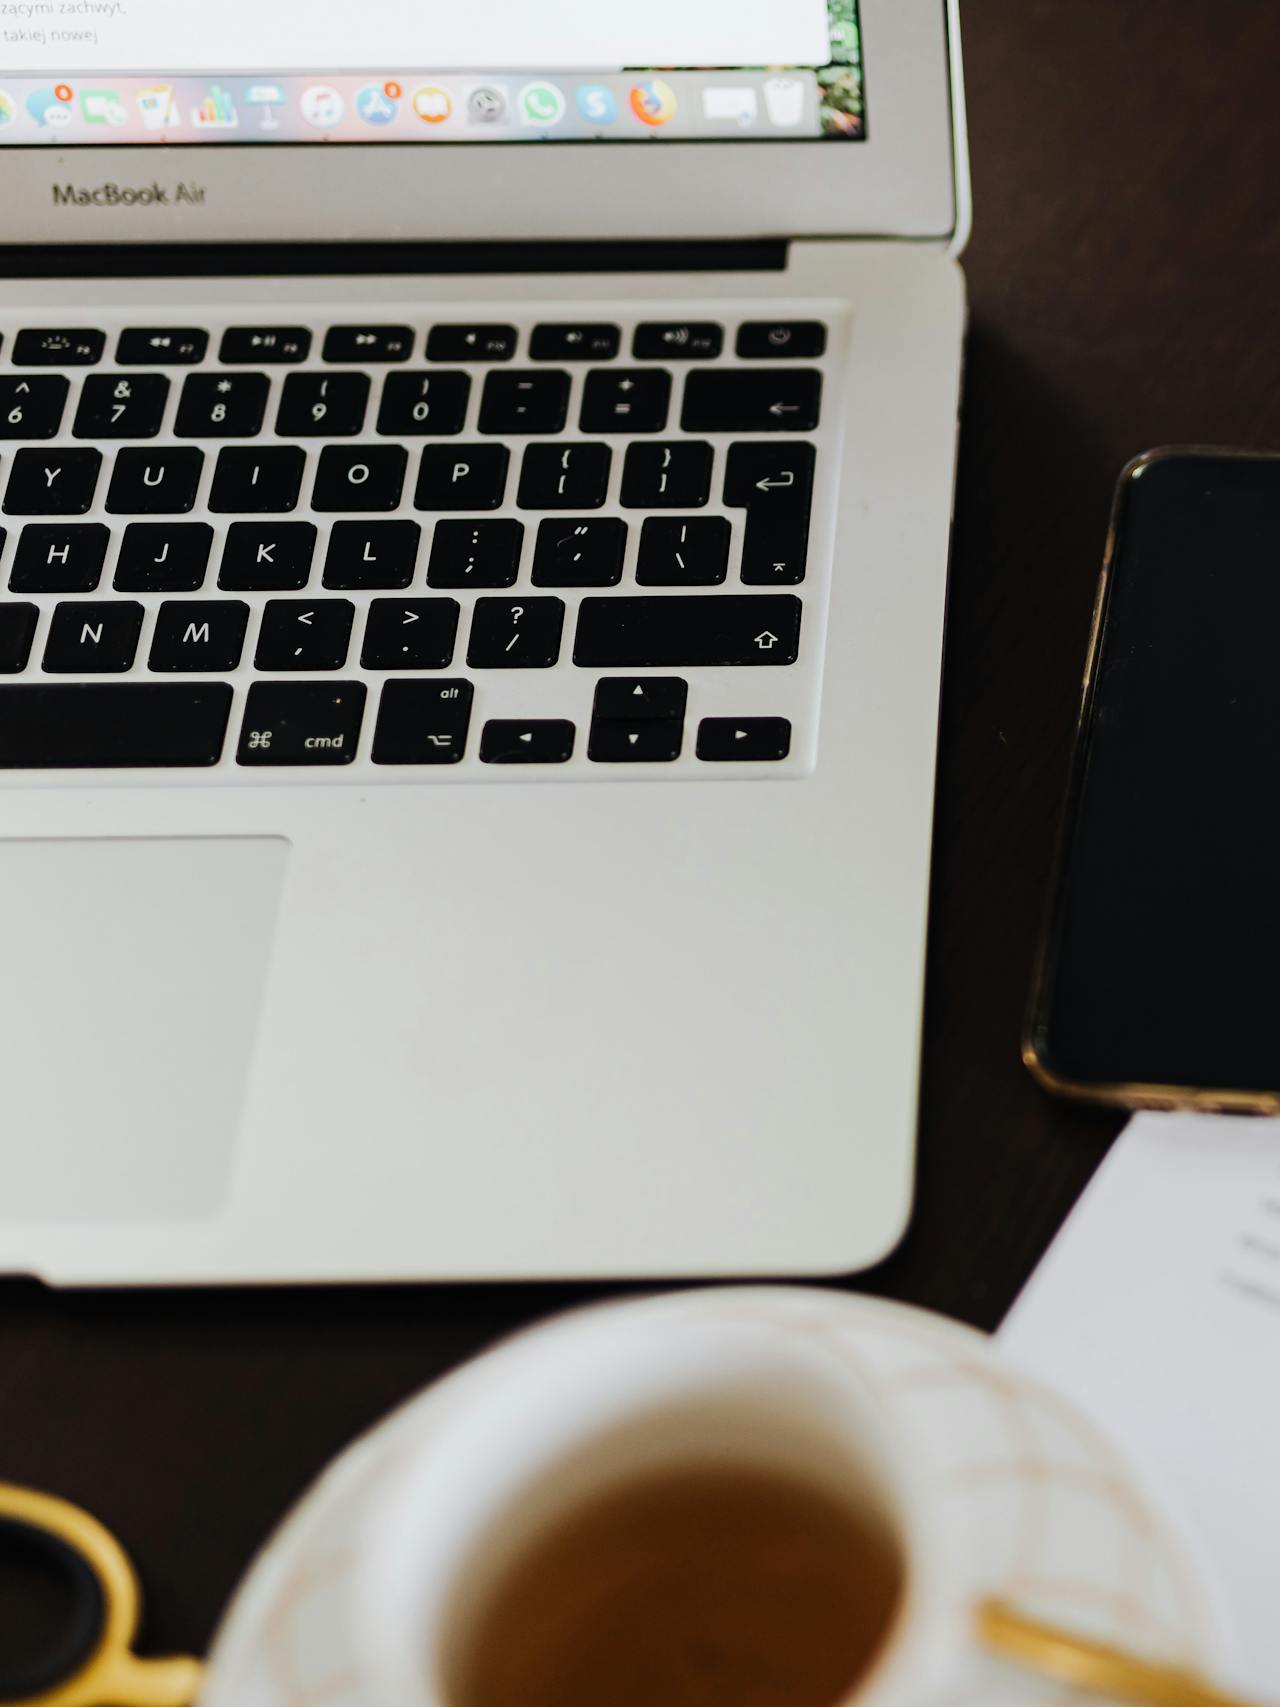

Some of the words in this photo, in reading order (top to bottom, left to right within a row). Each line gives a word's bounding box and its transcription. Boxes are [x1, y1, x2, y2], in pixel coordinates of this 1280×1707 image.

[4, 27, 46, 45] takiej
[51, 28, 98, 45] nowej
[52, 181, 169, 207] MacBook
[175, 181, 208, 206] Air
[114, 381, 132, 398] &
[8, 406, 23, 423] 6
[111, 405, 127, 422] 7
[211, 404, 227, 422] 8
[312, 403, 328, 421] 9
[412, 402, 429, 420] 0
[615, 403, 631, 414] =
[562, 449, 571, 468] {
[663, 449, 672, 468] }
[45, 468, 62, 488] Y
[143, 467, 165, 487] U
[251, 466, 260, 485] I
[347, 464, 370, 484] O
[452, 463, 470, 483] P
[558, 475, 567, 494] [
[660, 474, 668, 493] ]
[46, 545, 70, 564] H
[154, 543, 170, 563] J
[257, 544, 277, 563] K
[363, 542, 377, 562] L
[298, 611, 315, 625] <
[403, 611, 420, 625] >
[511, 607, 524, 625] ?
[80, 623, 104, 644] N
[183, 623, 210, 643] M
[506, 634, 520, 652] /
[440, 687, 459, 699] alt
[304, 734, 345, 749] cmd
